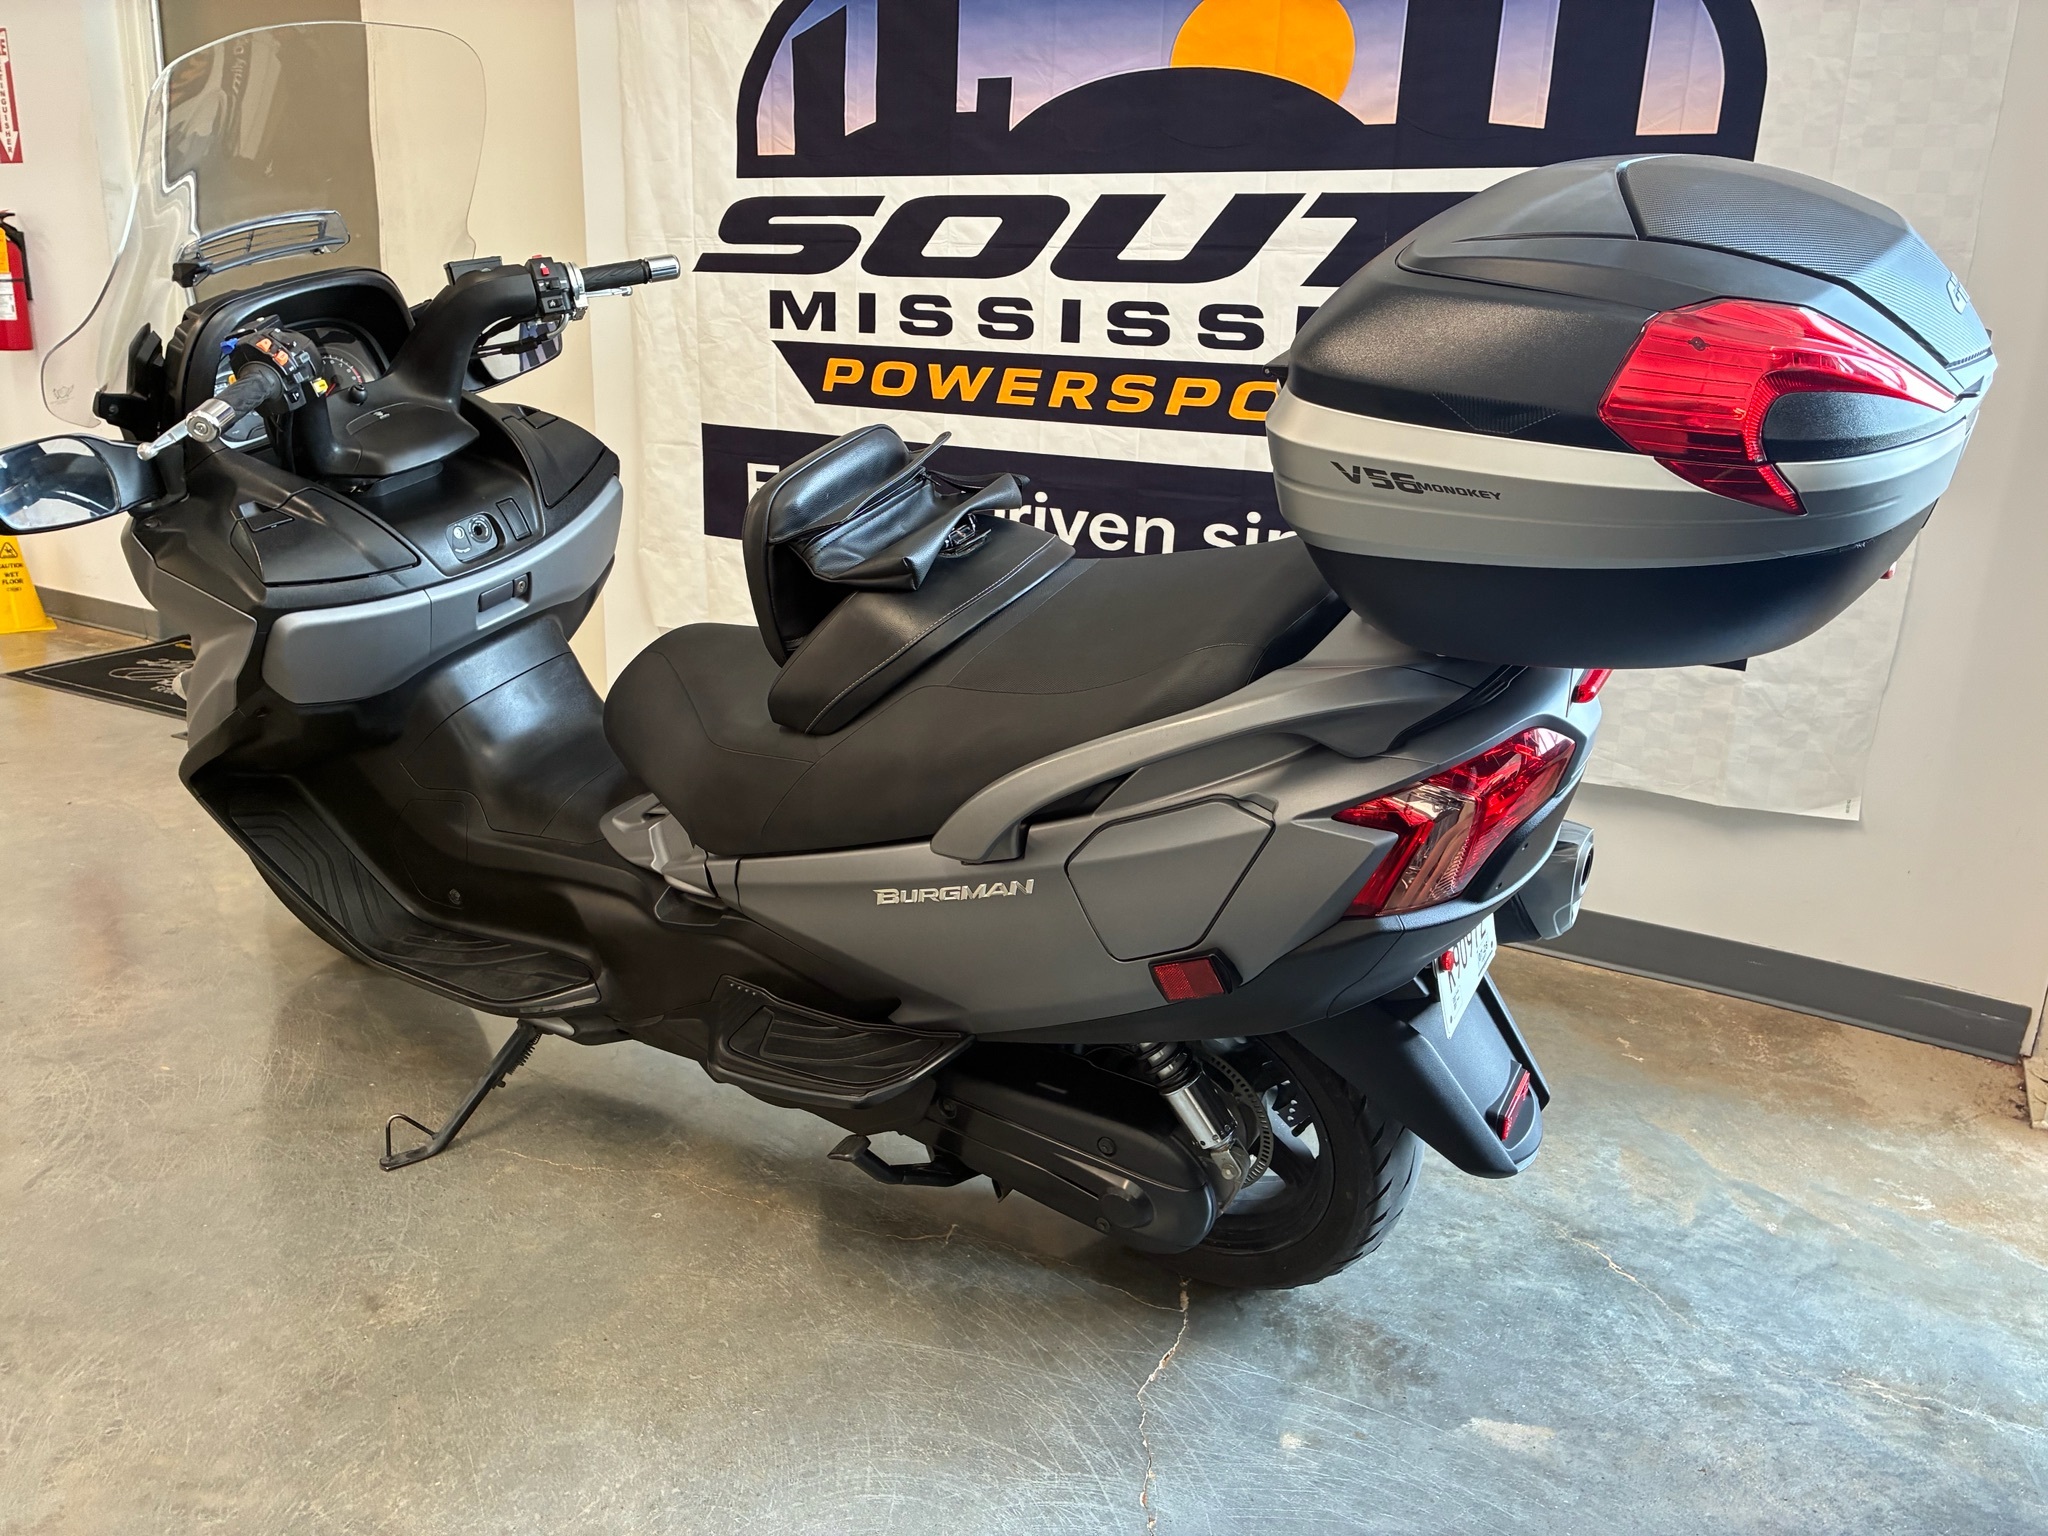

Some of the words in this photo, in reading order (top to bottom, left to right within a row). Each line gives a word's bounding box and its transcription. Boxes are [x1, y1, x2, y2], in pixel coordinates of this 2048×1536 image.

[1330, 461, 1424, 495] V56
[1416, 481, 1502, 501] MONOKEY
[994, 491, 1175, 555] riven
[1203, 511, 1297, 549] si
[872, 879, 1035, 906] BURGMAN
